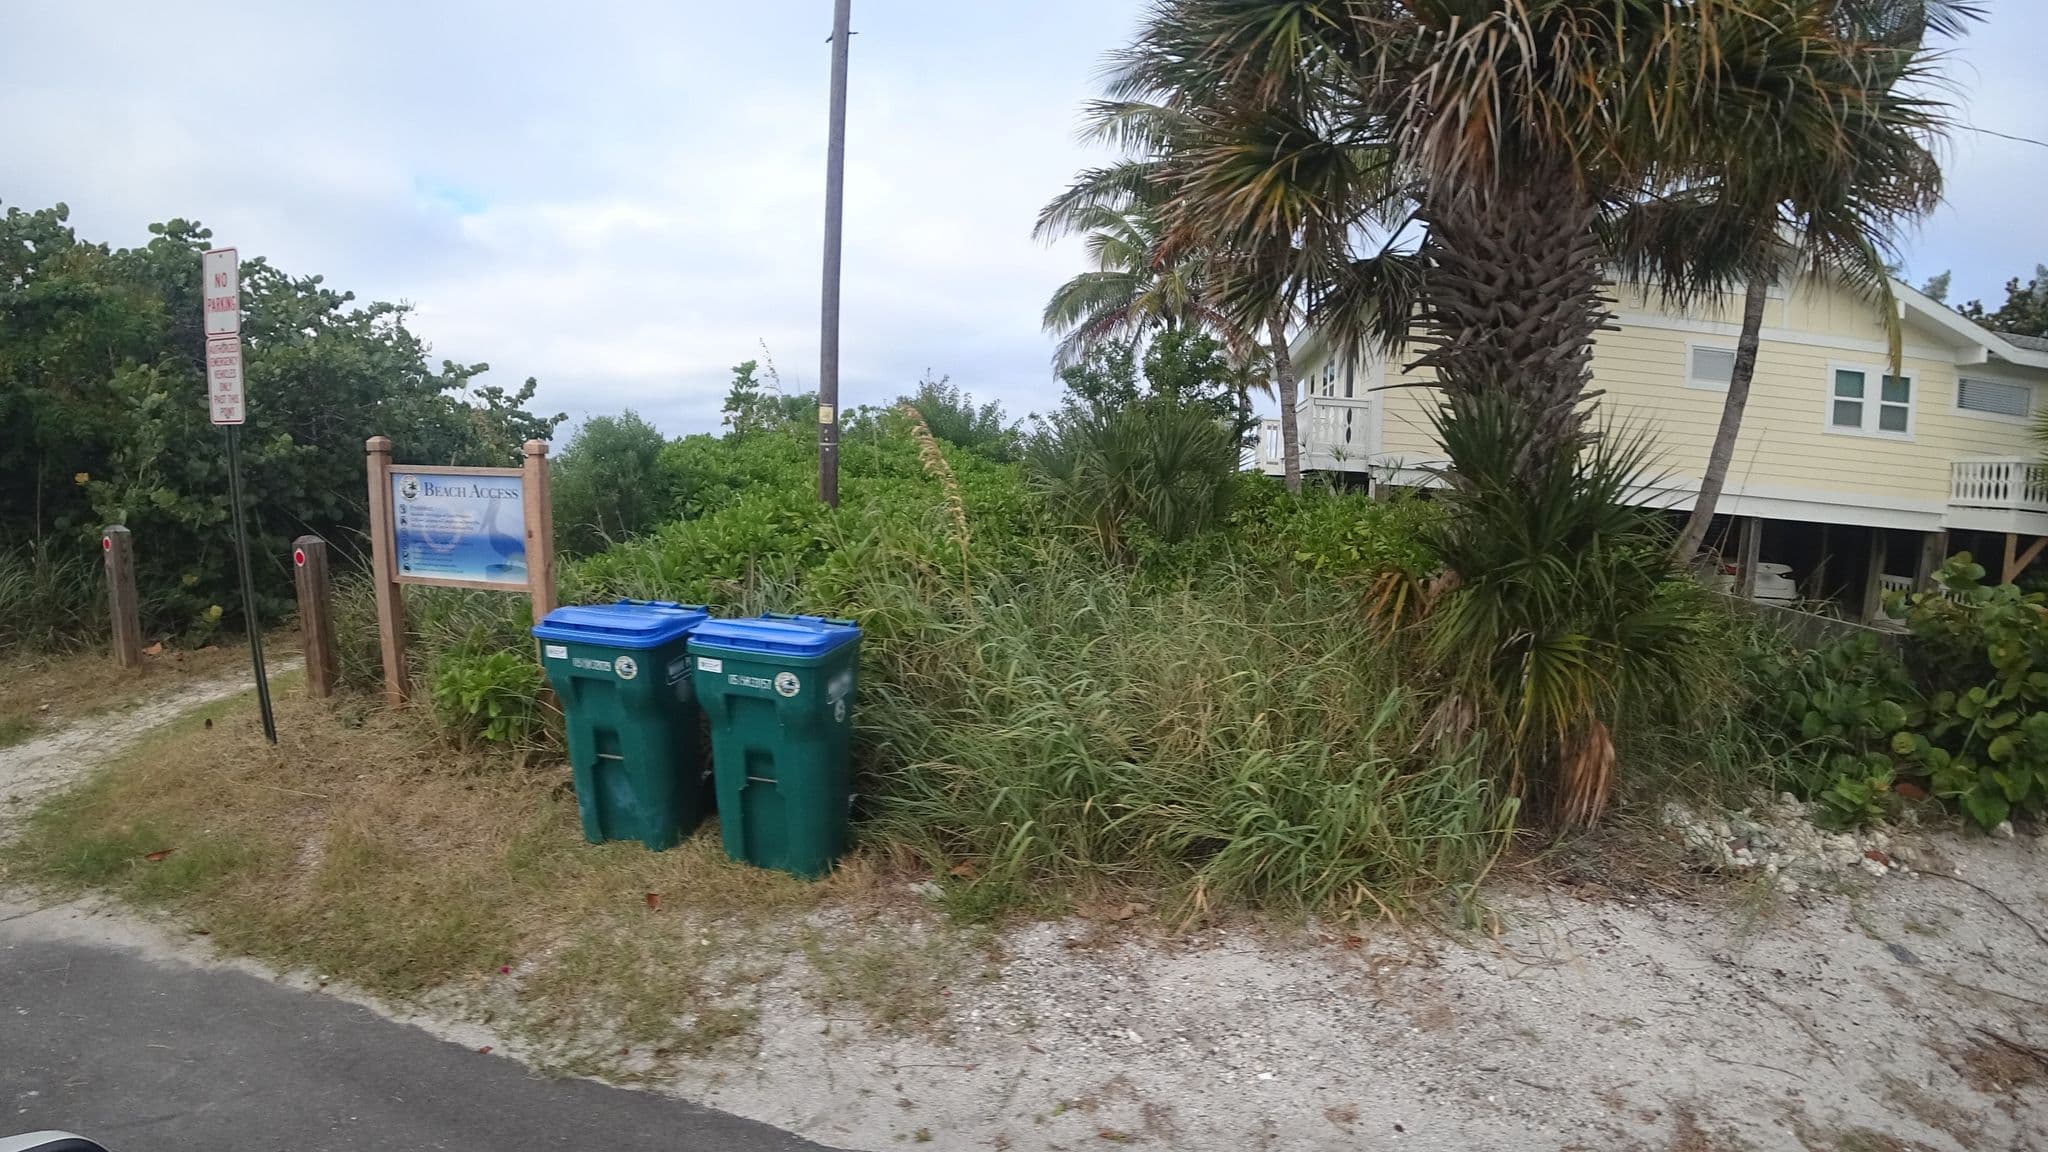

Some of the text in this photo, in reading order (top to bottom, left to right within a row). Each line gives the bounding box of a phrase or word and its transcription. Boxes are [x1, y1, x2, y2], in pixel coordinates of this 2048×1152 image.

[214, 272, 228, 288] NO
[207, 295, 236, 313] PARKING
[424, 481, 466, 498] BEACH
[470, 484, 519, 500] ACCESS
